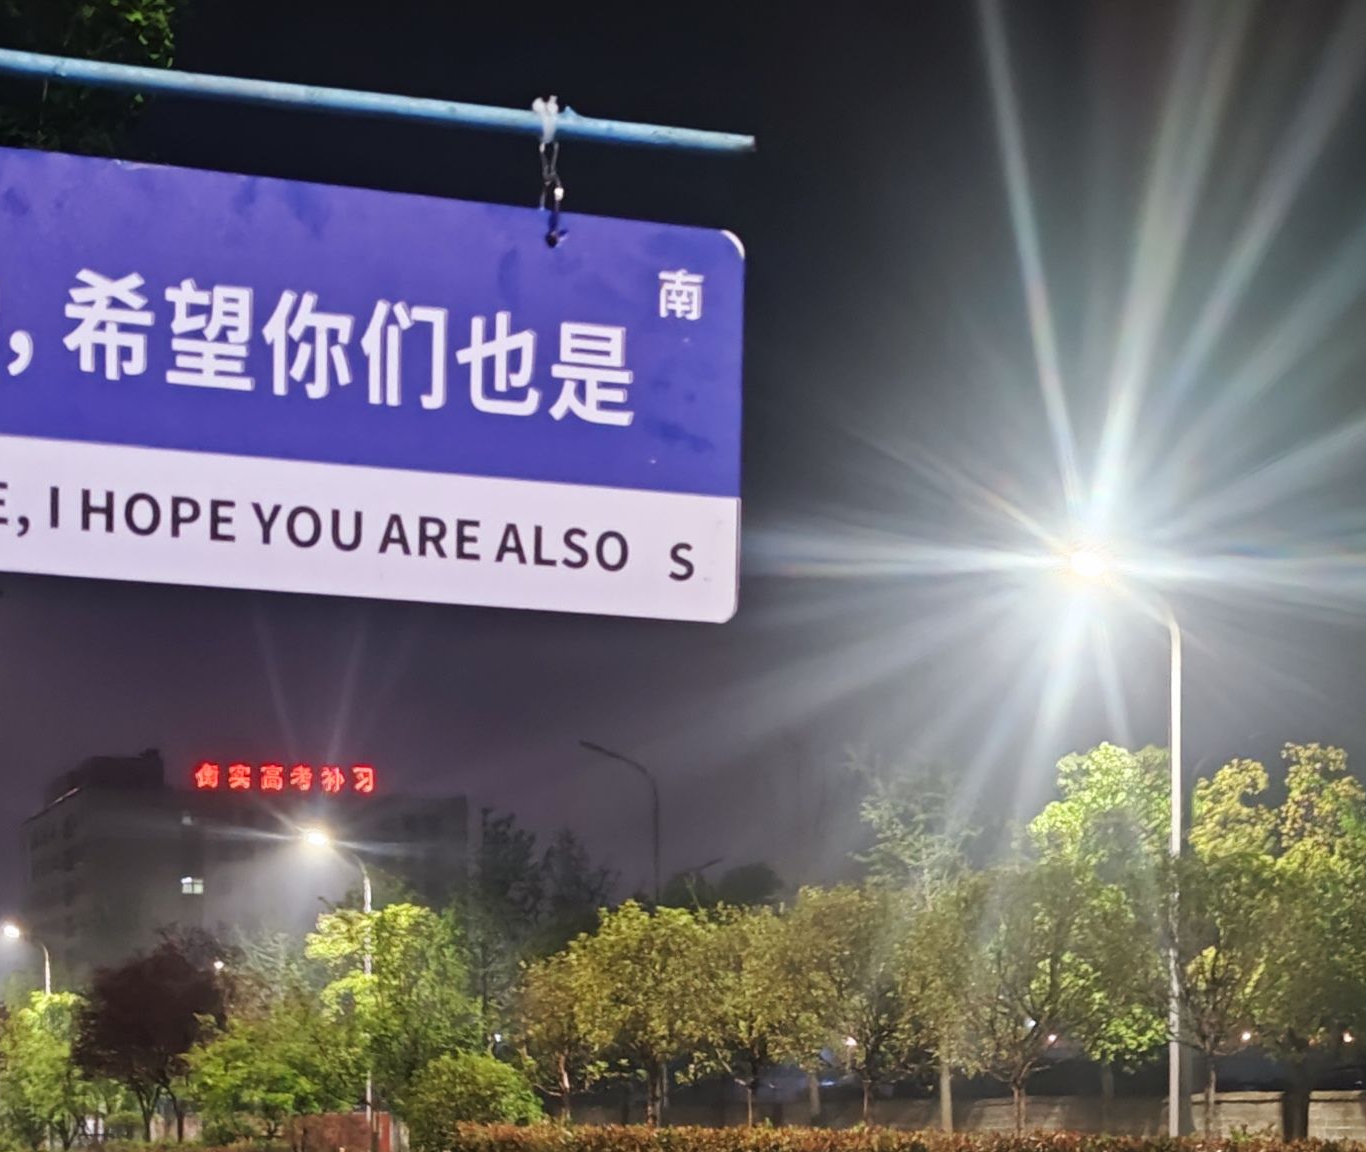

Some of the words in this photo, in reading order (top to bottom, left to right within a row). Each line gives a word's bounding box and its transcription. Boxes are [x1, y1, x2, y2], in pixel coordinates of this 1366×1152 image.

[657, 267, 705, 322] 南
[49, 486, 61, 529] I
[81, 488, 237, 543] HOPE
[251, 502, 363, 553] YOU
[378, 513, 481, 562] ARE
[495, 523, 629, 573] ALSO
[668, 541, 695, 583] S
